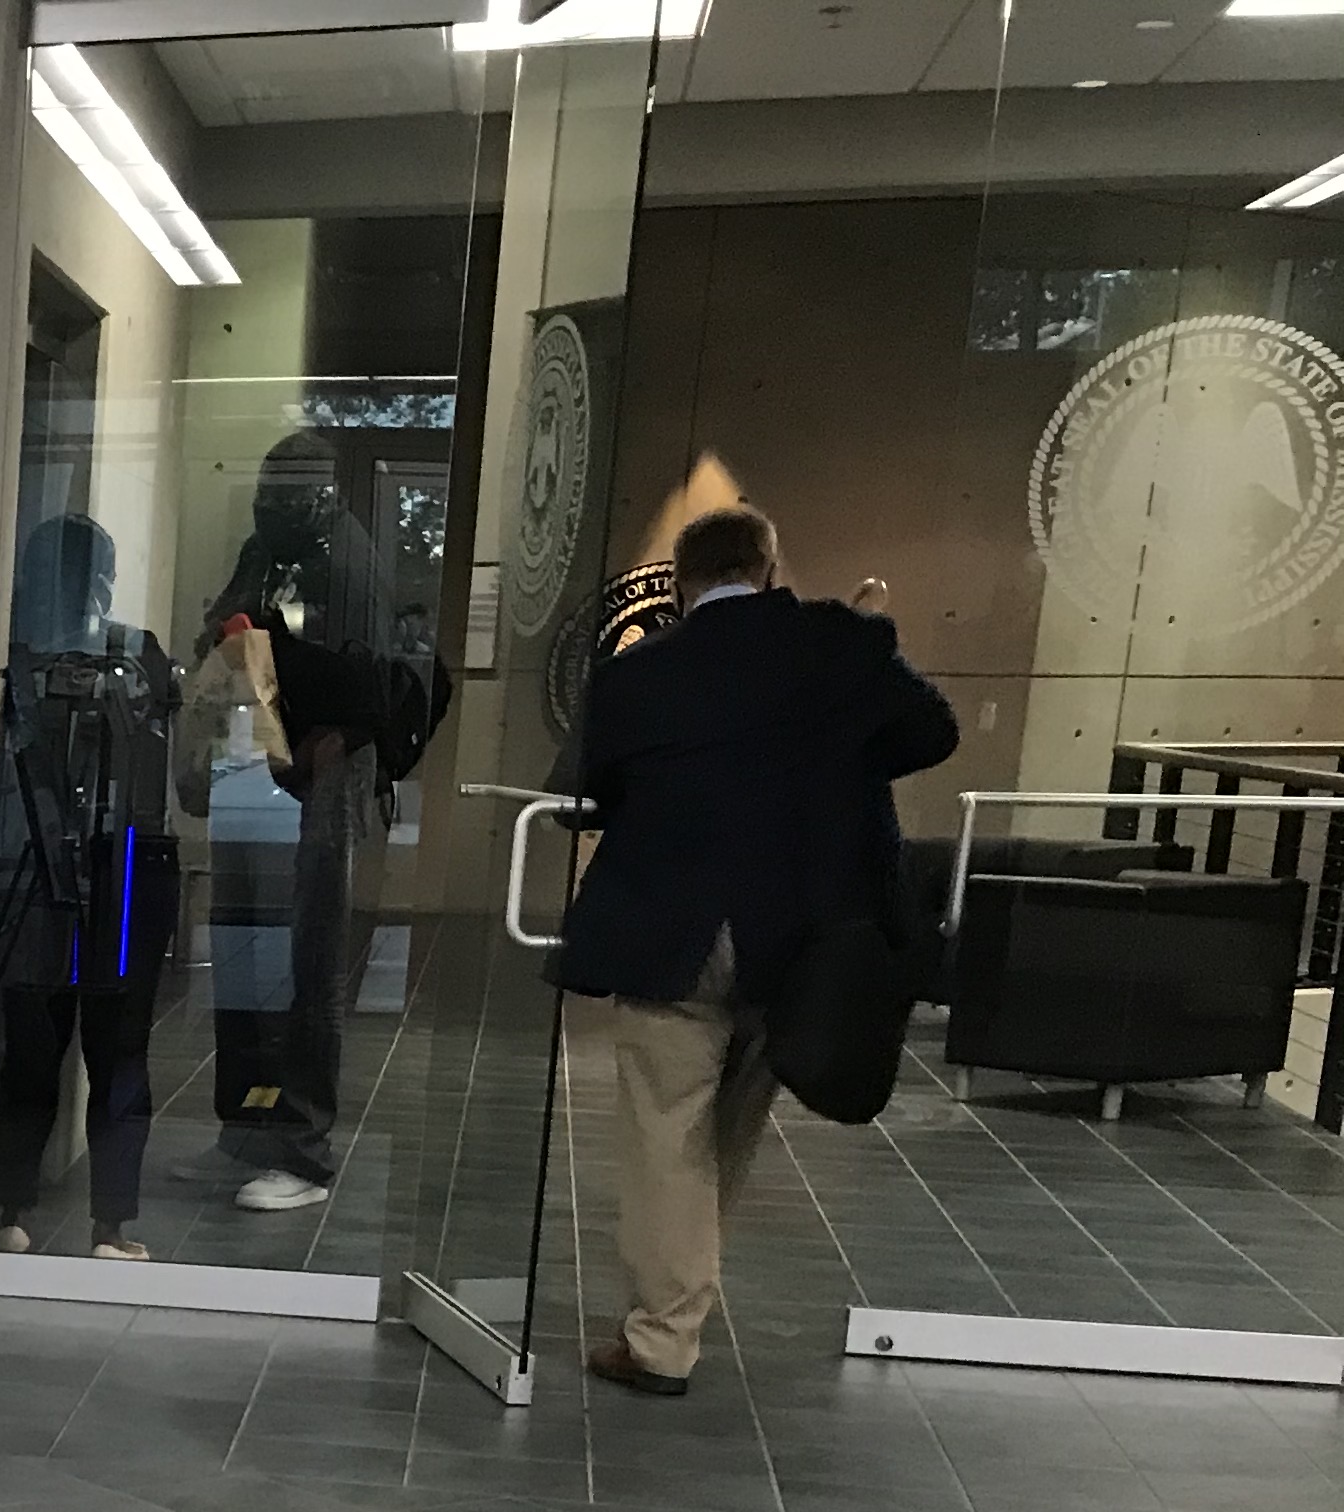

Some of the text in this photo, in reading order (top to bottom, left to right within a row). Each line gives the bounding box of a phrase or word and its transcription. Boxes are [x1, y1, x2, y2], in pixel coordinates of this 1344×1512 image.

[1175, 332, 1248, 360] THE
[1249, 337, 1339, 403] STATE
[625, 580, 647, 600] OF
